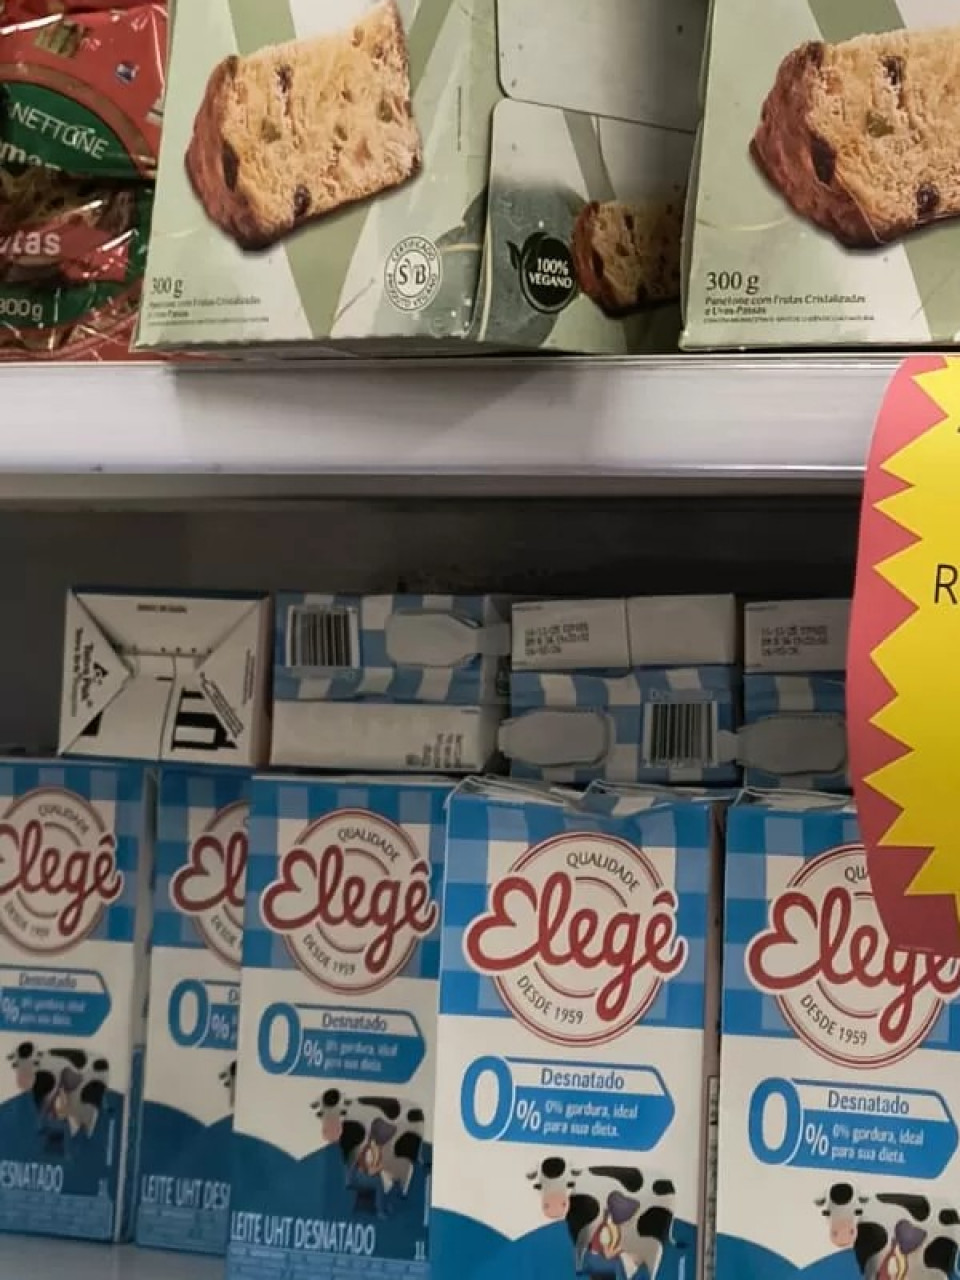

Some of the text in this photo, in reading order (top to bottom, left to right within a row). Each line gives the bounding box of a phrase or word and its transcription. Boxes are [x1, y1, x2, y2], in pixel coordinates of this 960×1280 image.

[529, 271, 573, 291] VEGANO
[536, 258, 569, 276] 100%
[706, 271, 760, 294] 300 g
[337, 828, 400, 863] QUALIDADE
[566, 851, 640, 894] QUALIDADE
[263, 844, 436, 974] Elegê
[467, 871, 686, 1022] Elegê
[517, 975, 584, 1025] DESDE 1959
[800, 994, 867, 1045] DESDE 1959
[541, 1067, 625, 1090] Desnatado
[612, 1103, 638, 1119] ideal
[828, 1090, 910, 1115] Desnatado
[900, 1128, 923, 1145] ideal
[231, 1211, 376, 1255] LEITE UHT DESNATADO
